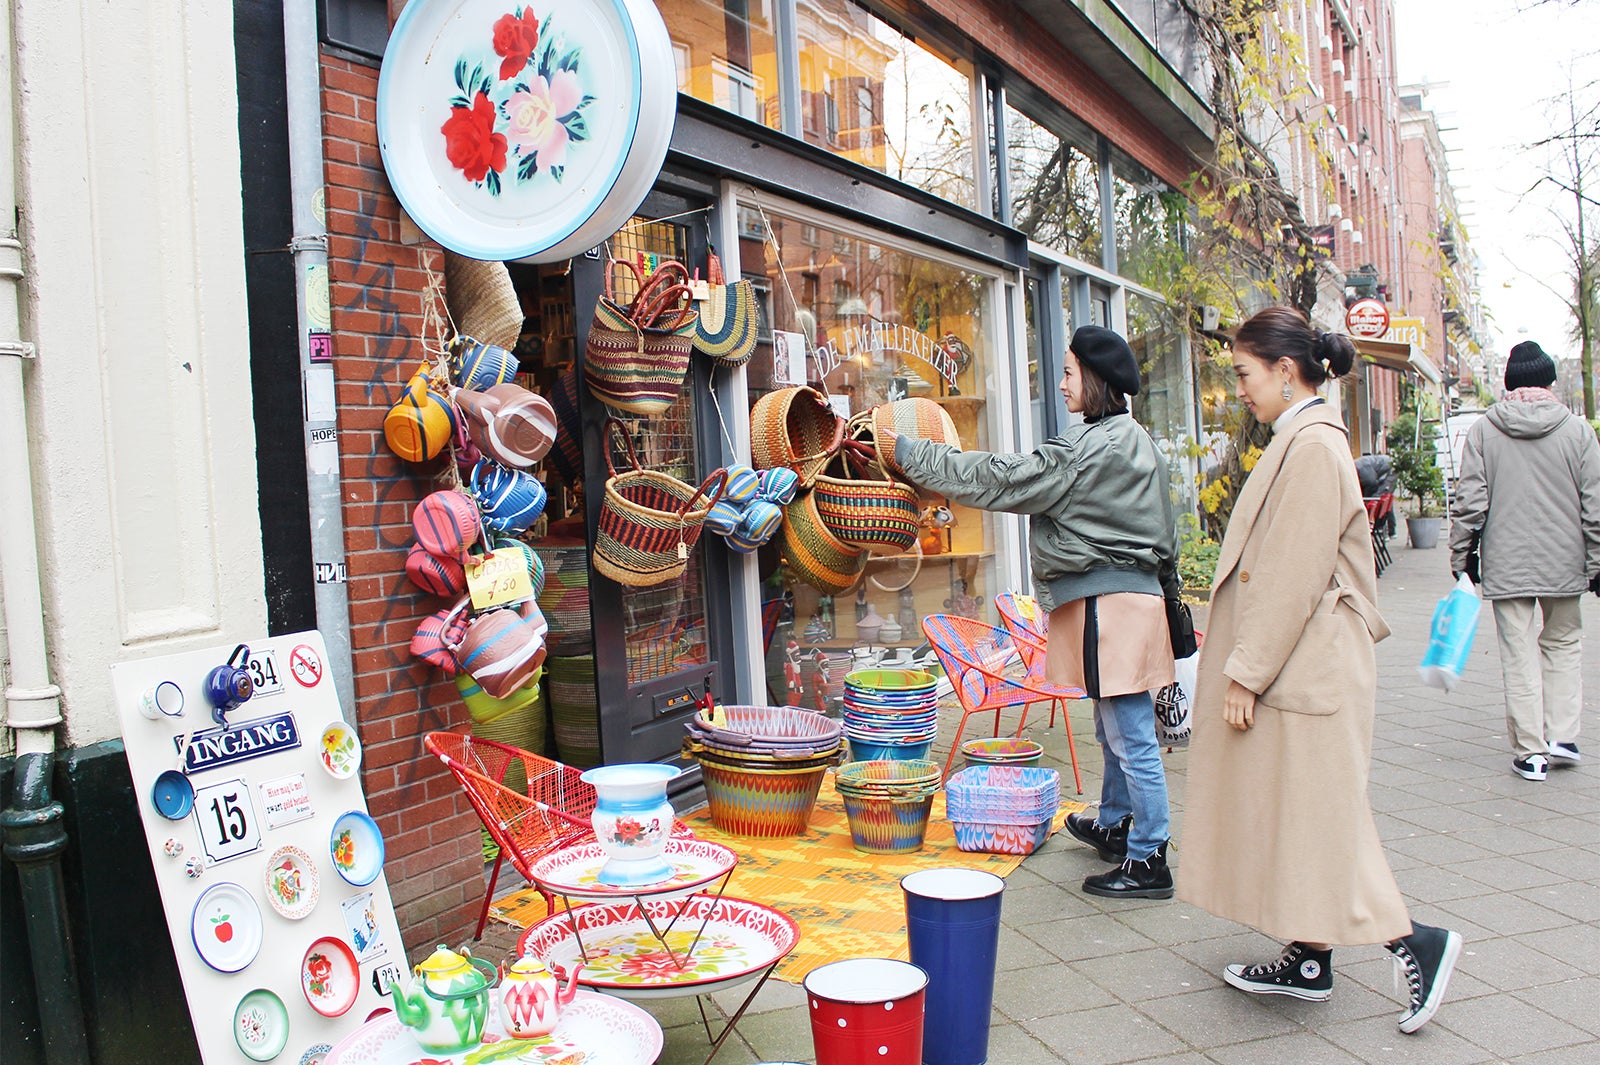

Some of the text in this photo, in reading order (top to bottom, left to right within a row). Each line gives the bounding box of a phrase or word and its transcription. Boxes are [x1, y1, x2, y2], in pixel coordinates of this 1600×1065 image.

[815, 338, 841, 380] DE
[842, 321, 958, 387] EMAILLEKEIZER
[250, 657, 278, 688] 34
[191, 720, 292, 764] INGANG
[210, 792, 247, 845] 15
